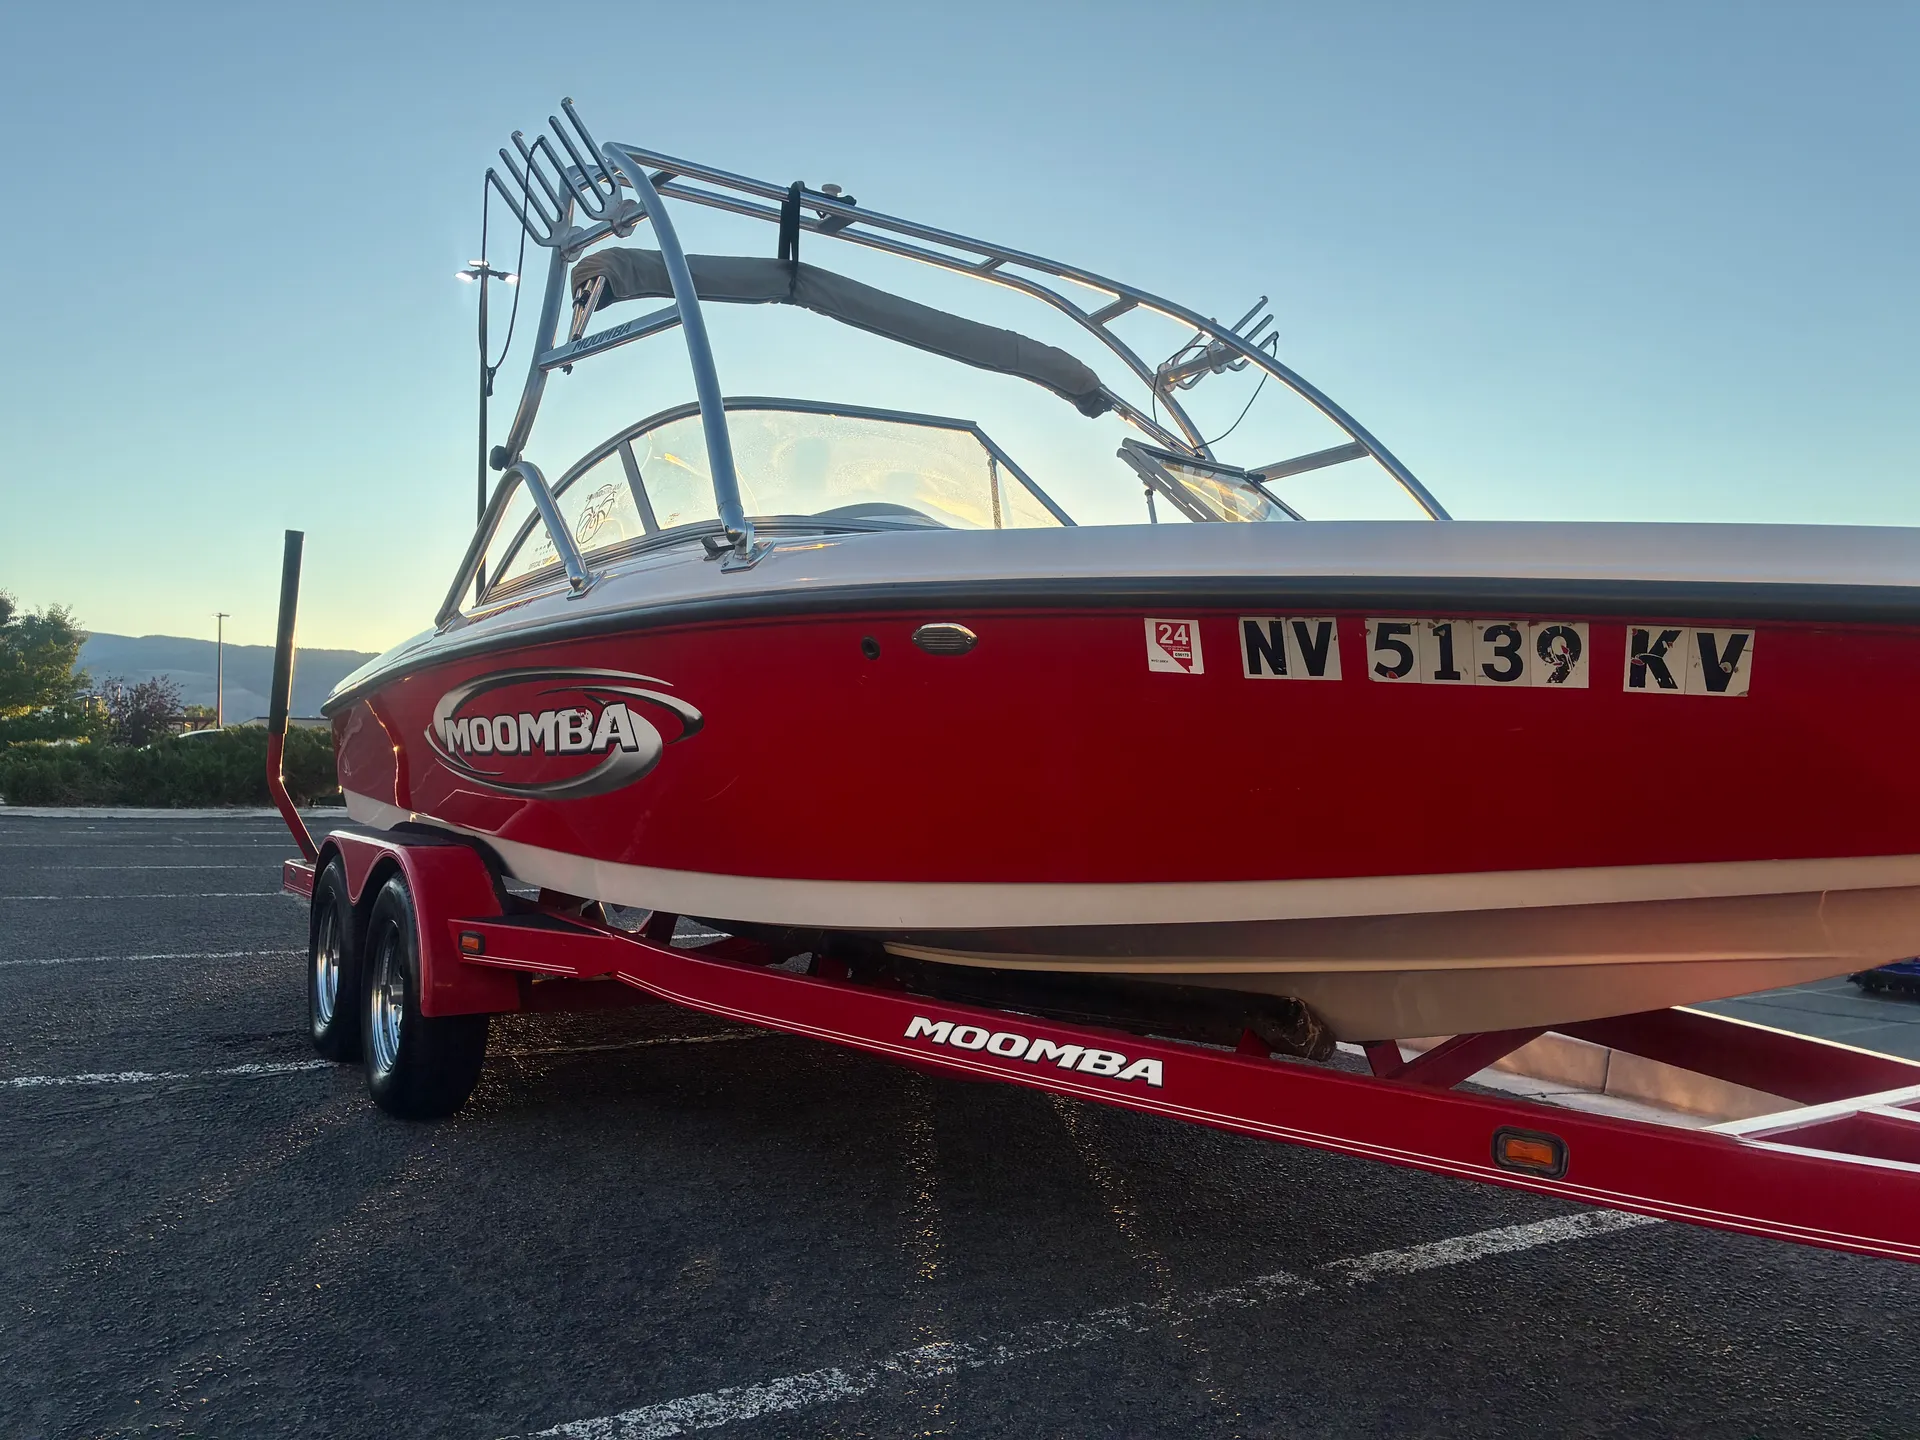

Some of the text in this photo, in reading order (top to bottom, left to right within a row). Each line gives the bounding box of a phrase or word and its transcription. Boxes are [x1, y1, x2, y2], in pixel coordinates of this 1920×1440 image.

[572, 322, 632, 353] MOOMBA
[1158, 624, 1189, 645] 24
[1243, 620, 1750, 693] NV 5139 KV
[444, 702, 639, 756] MOOMBA
[903, 1016, 1163, 1087] MOOMBA
